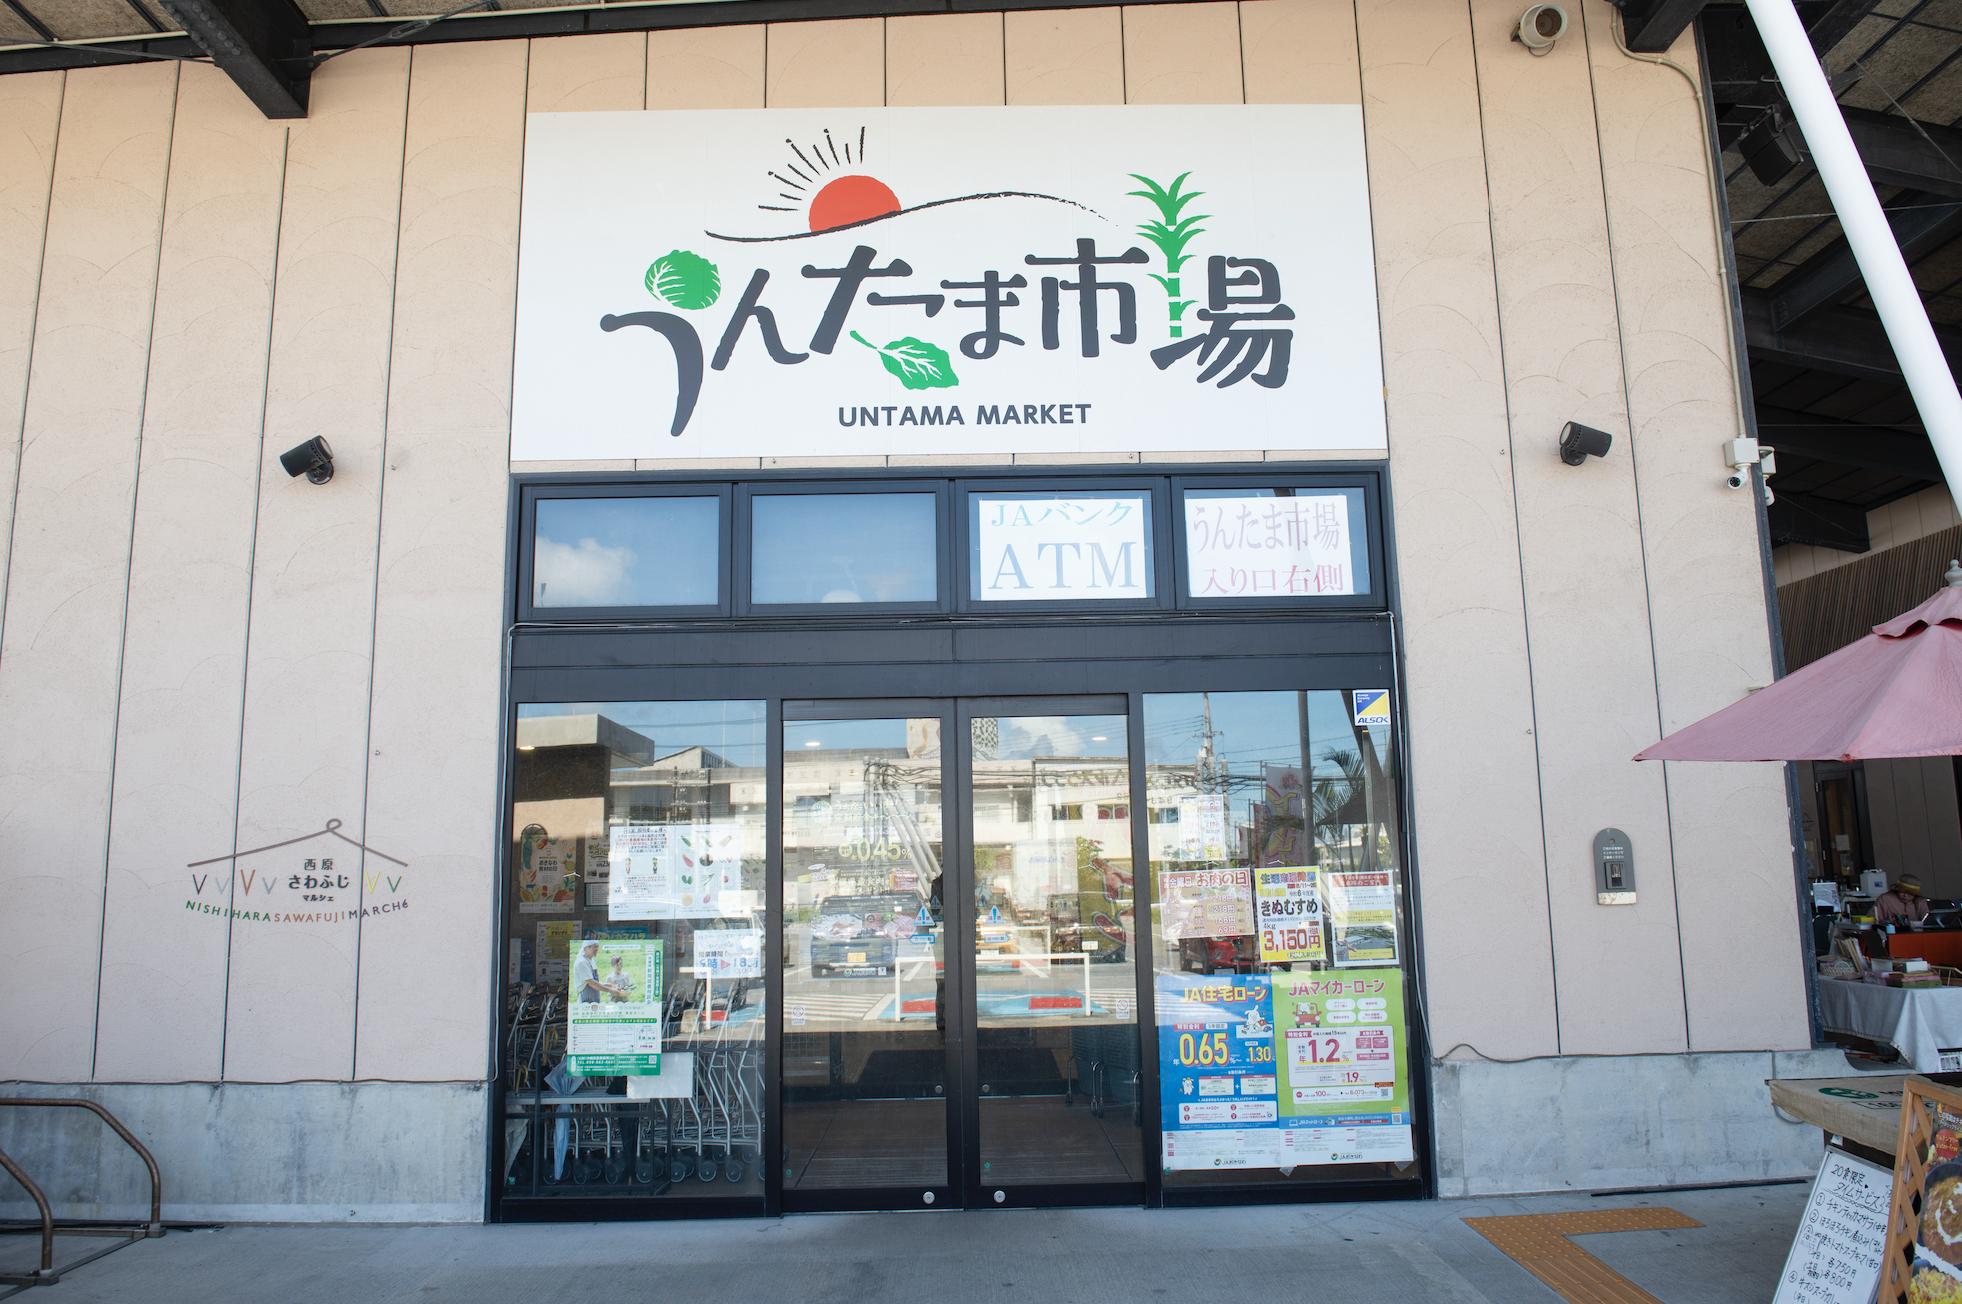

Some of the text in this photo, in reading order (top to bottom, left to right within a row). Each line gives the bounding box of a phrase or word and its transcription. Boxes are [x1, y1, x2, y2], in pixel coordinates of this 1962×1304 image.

[600, 237, 1296, 437] うんたま市場
[838, 403, 1092, 427] UNTAMA MARKET
[991, 501, 1133, 527] JAバンク
[1193, 501, 1340, 552] うんたま市場
[987, 541, 1138, 589] ATM
[1201, 563, 1344, 594] 入り口右側
[1357, 716, 1389, 724] ALSOK
[303, 858, 334, 871] 西原
[287, 874, 350, 889] さわふじ
[302, 894, 335, 902] マルシェ
[1260, 898, 1318, 917] きぬむすめ
[185, 900, 271, 922] NISHIHARA
[274, 911, 346, 924] SAWAFUJI
[1183, 985, 1268, 1003] JA住宅ローン
[1289, 979, 1385, 996] JAマイカーローン
[1179, 1032, 1230, 1067] 0.65
[1248, 1046, 1273, 1063] 1.30
[1308, 1038, 1341, 1063] 1.2
